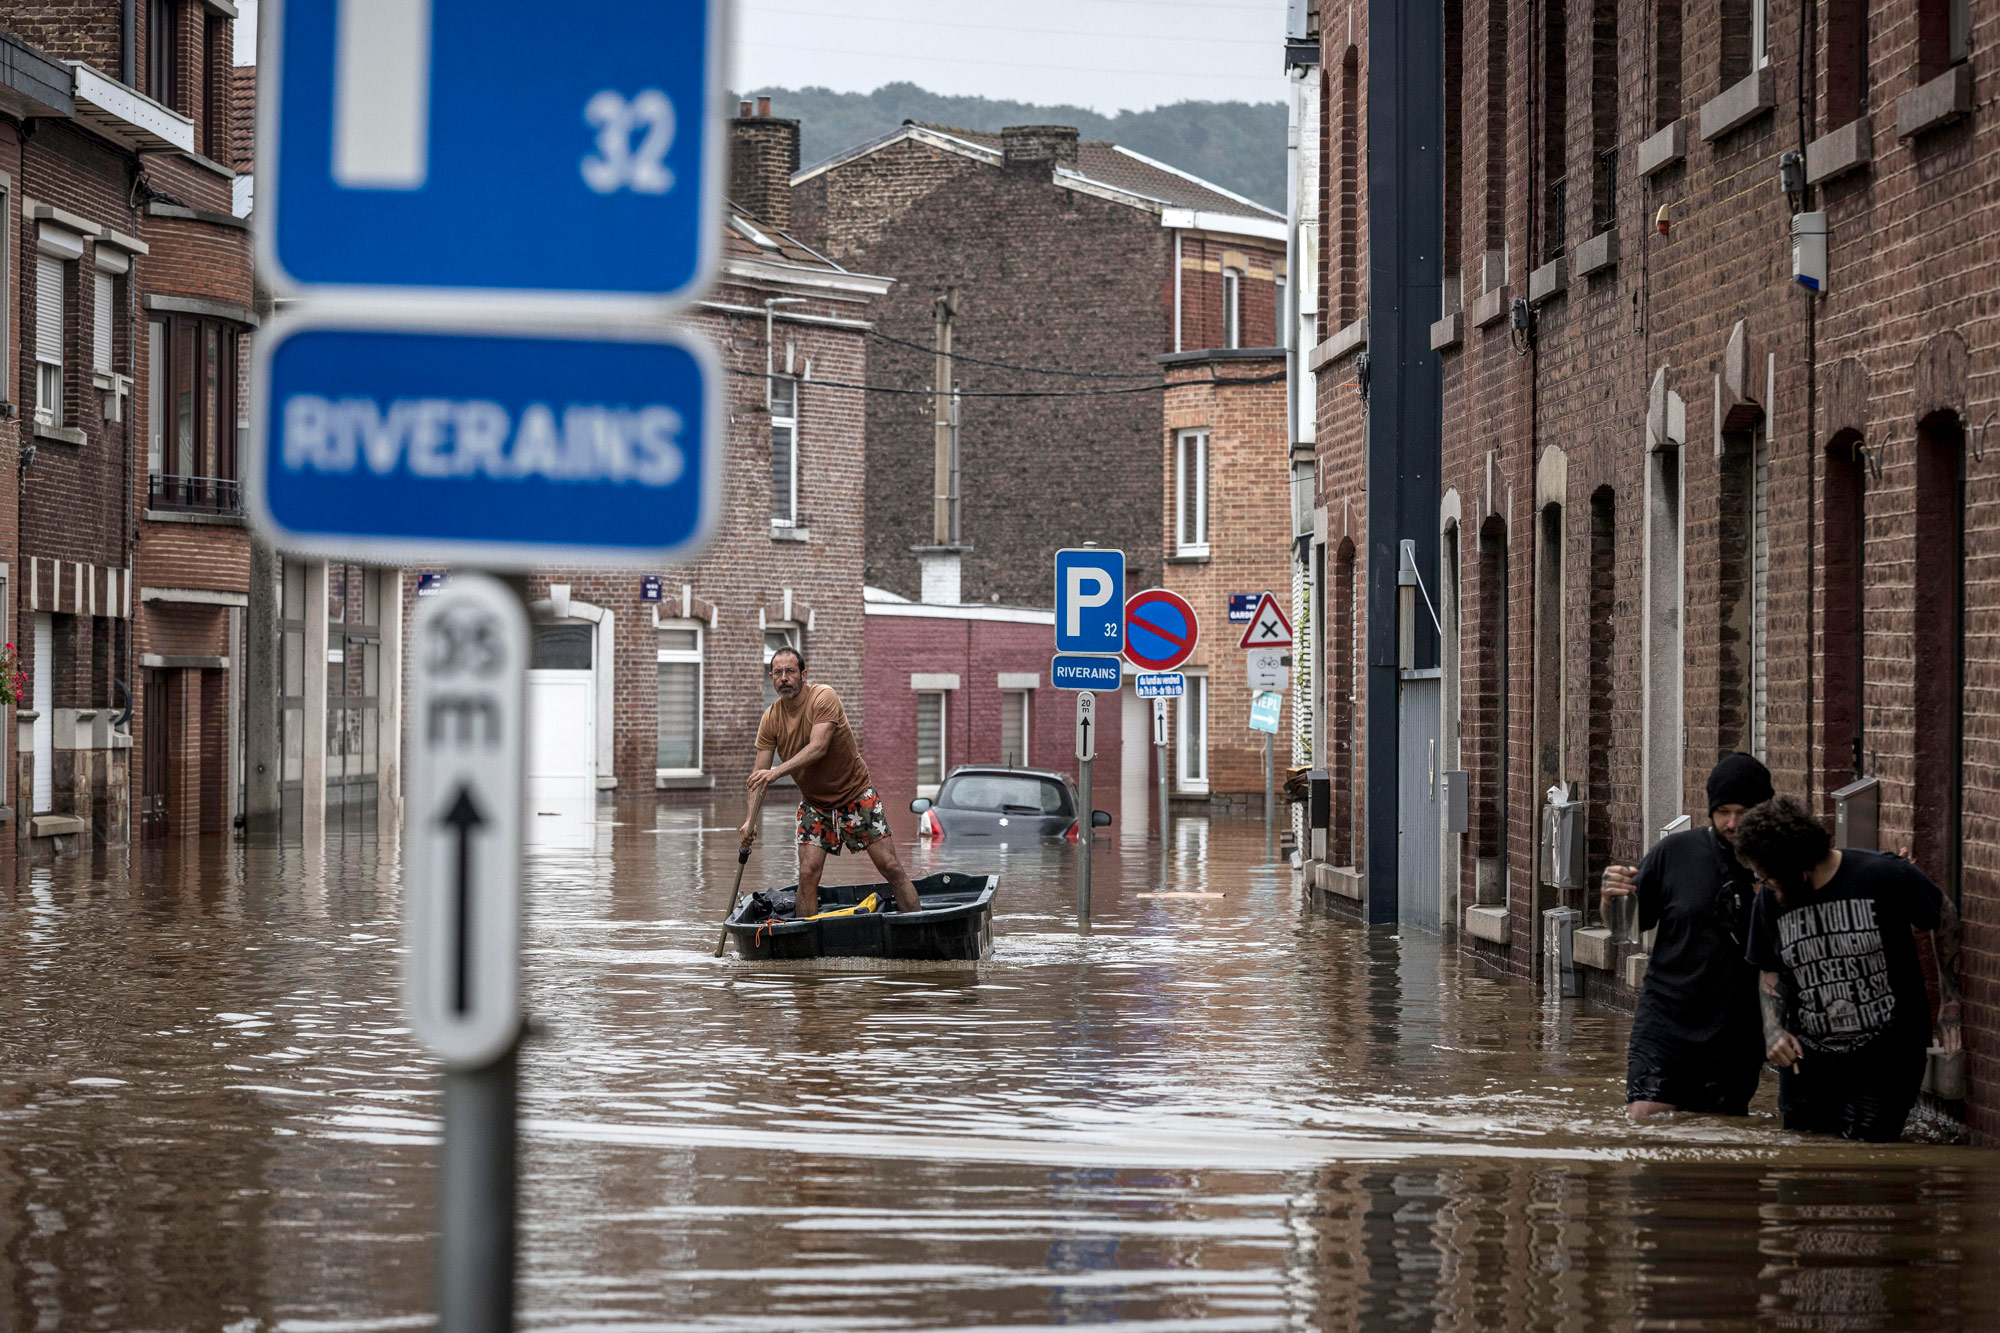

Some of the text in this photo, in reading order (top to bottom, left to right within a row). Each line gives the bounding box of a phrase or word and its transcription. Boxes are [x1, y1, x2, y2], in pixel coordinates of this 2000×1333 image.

[578, 88, 678, 195] 32
[281, 392, 686, 489] RIVERAINS
[1066, 567, 1114, 637] P
[1104, 623, 1118, 638] 32
[1056, 666, 1117, 680] RIVERAINS
[1163, 675, 1180, 685] vendredi
[1081, 699, 1091, 707] 20
[426, 695, 503, 750] m
[1777, 898, 1879, 948] WHEN YOU DIE
[1797, 935, 1828, 964] ONLY
[1828, 930, 1884, 957] KINGDOM
[1818, 957, 1846, 984] SEE
[1843, 955, 1860, 981] IS
[1859, 950, 1887, 977] TWO
[1855, 978, 1873, 1004] &
[1869, 970, 1893, 999] SIX
